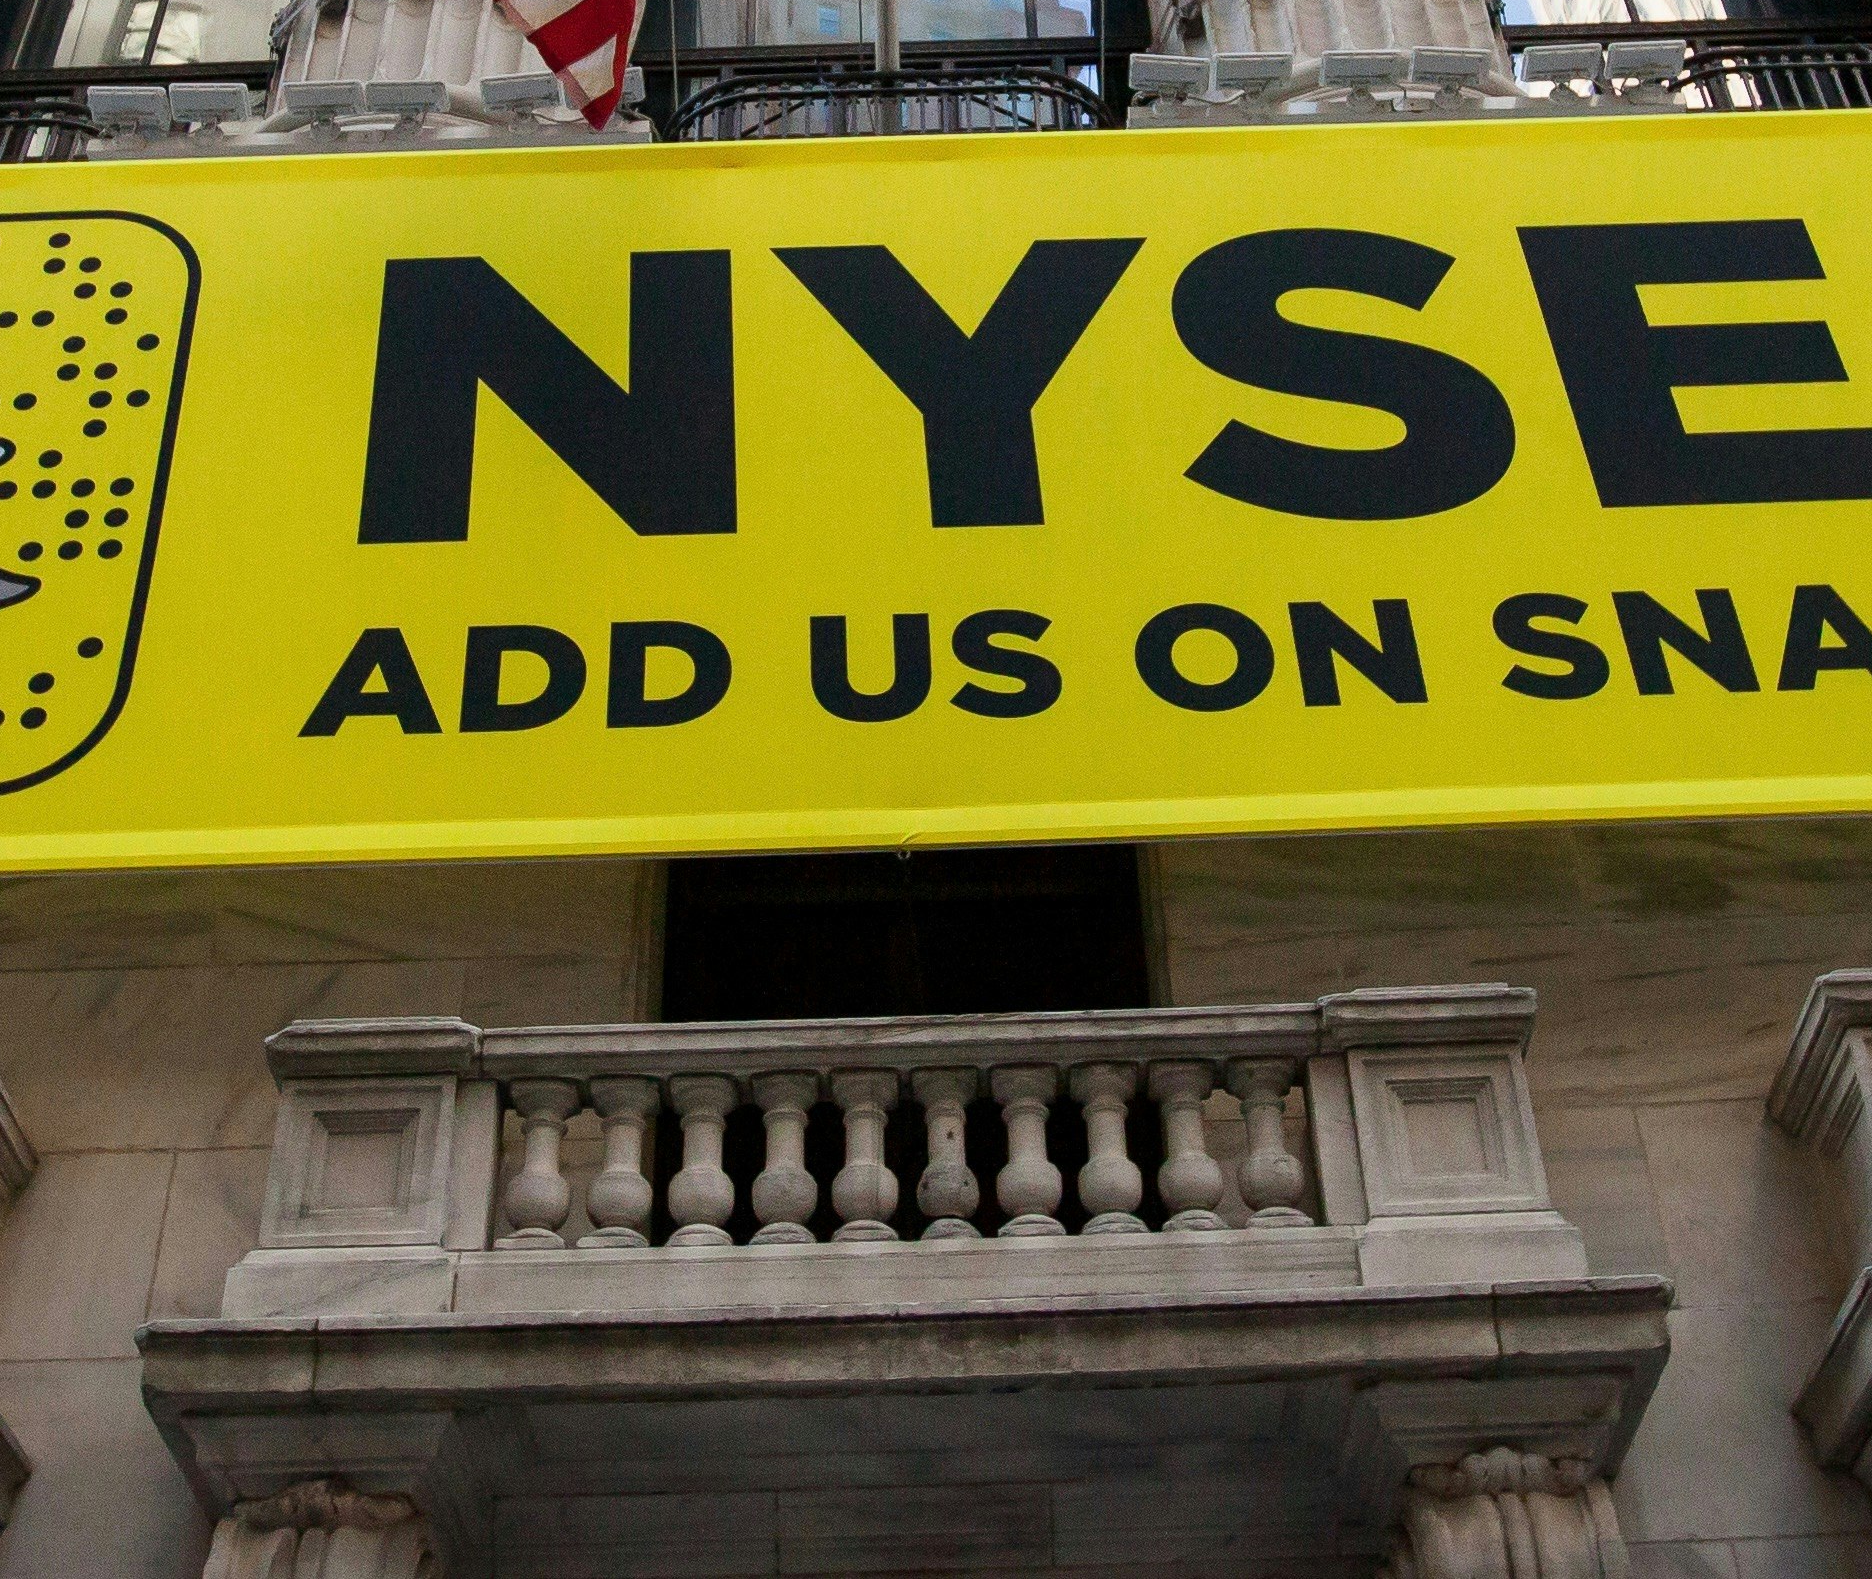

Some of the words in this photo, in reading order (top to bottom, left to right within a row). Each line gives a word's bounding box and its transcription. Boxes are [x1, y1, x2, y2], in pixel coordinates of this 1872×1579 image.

[297, 621, 732, 737] ADD
[810, 609, 1062, 722] US
[1135, 599, 1428, 712] ON
